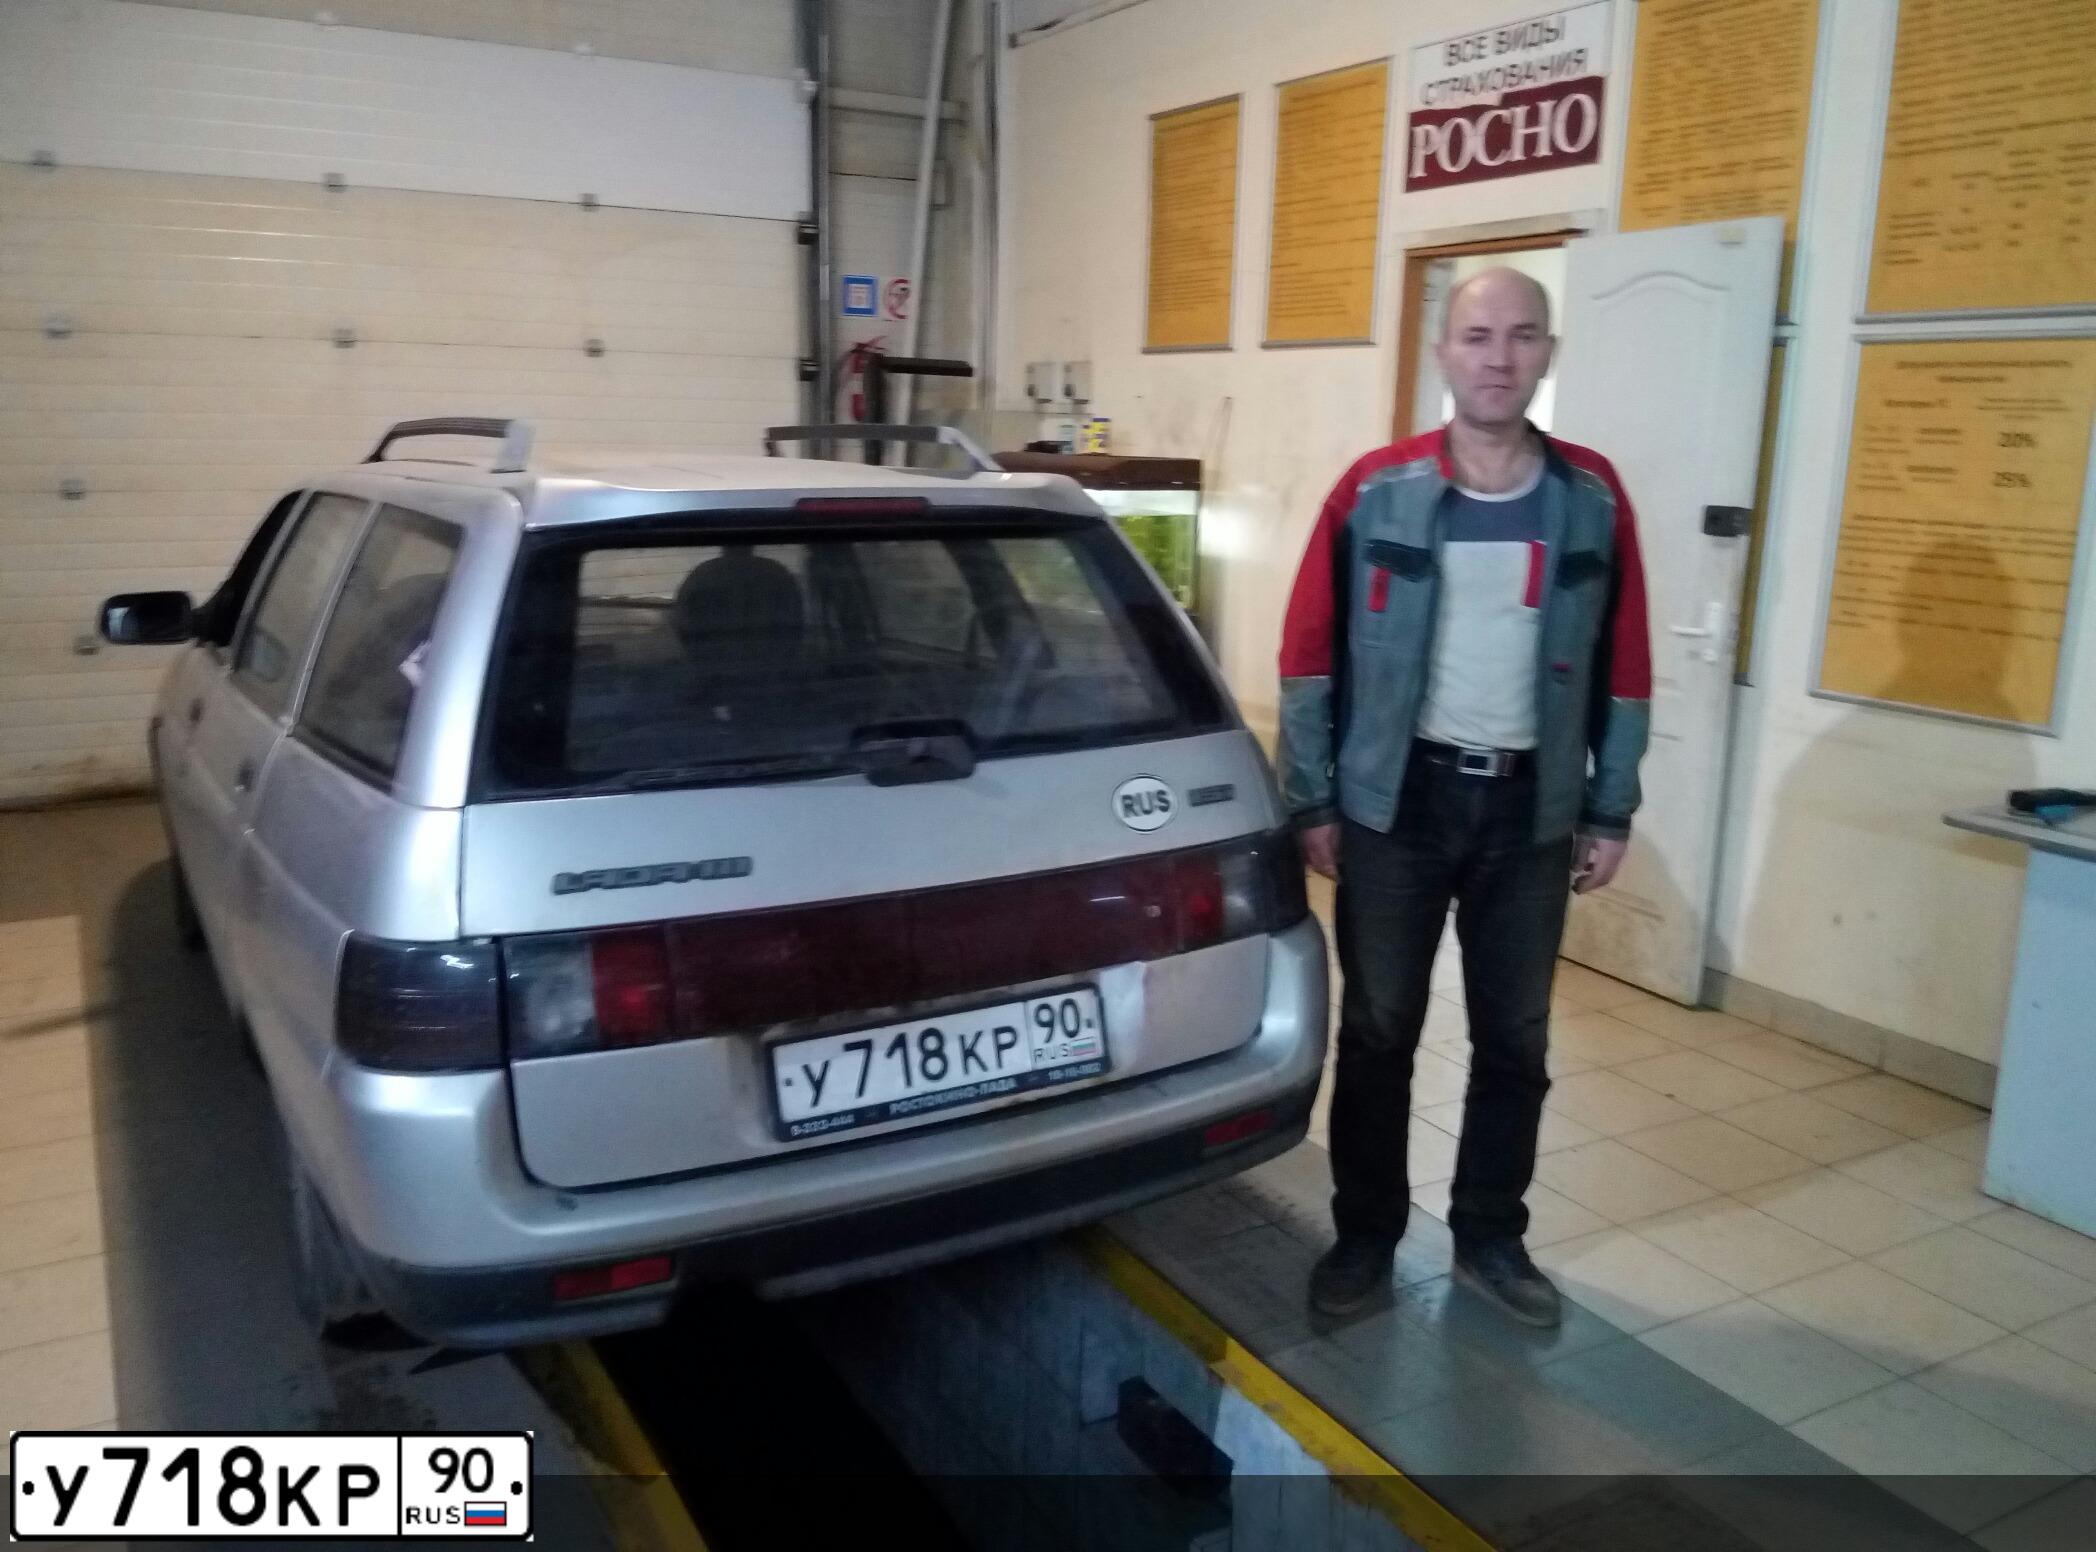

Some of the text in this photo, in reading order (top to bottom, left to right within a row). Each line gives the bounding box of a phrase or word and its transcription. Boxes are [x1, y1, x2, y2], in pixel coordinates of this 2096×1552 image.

[1443, 15, 1566, 67] ВСЕ ВИДЫ
[1420, 47, 1589, 106] СТРАХОВАНИЯ
[1408, 93, 1599, 179] РОСНО
[1120, 789, 1172, 818] RUS
[1033, 998, 1080, 1044] 90
[801, 1026, 1018, 1108] У718КР
[1034, 1043, 1069, 1064] RUS
